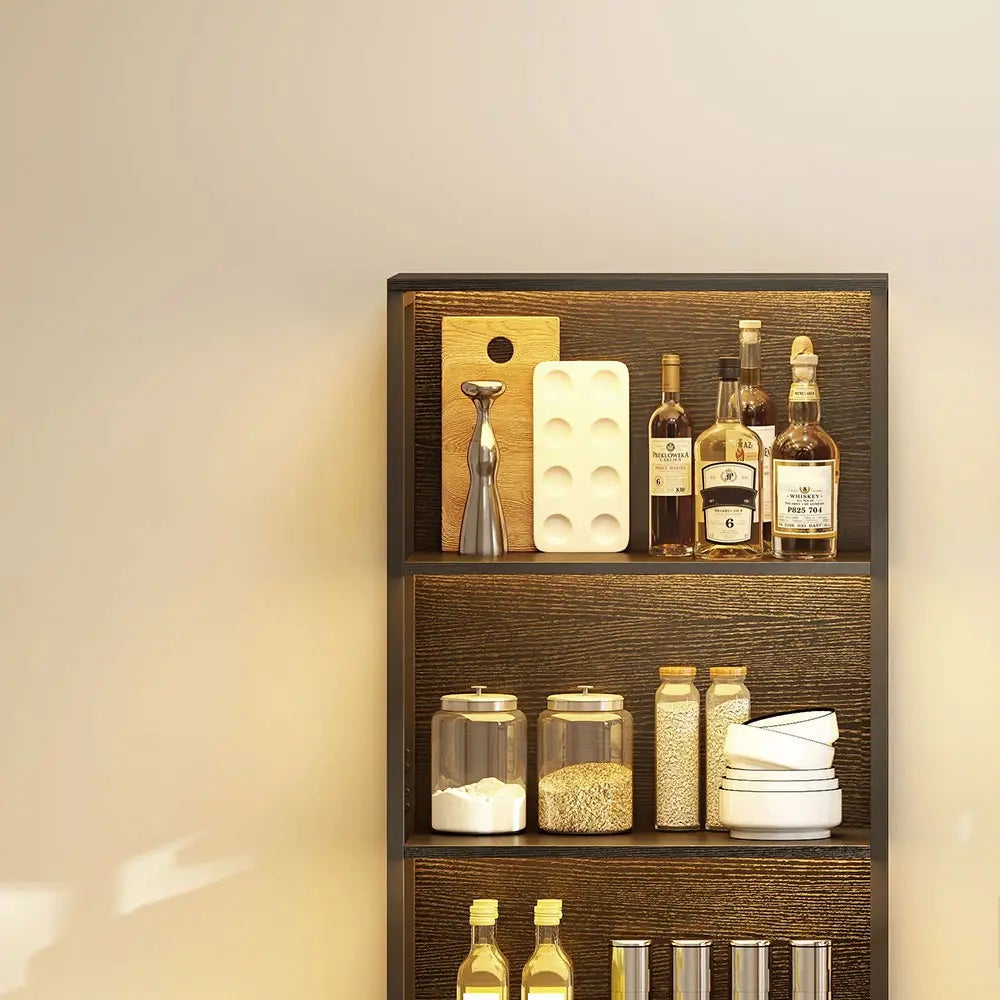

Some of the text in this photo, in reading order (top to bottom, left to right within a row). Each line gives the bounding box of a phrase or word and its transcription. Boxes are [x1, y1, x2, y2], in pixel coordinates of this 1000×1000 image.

[787, 506, 823, 514] P825 704
[725, 518, 735, 529] 6
